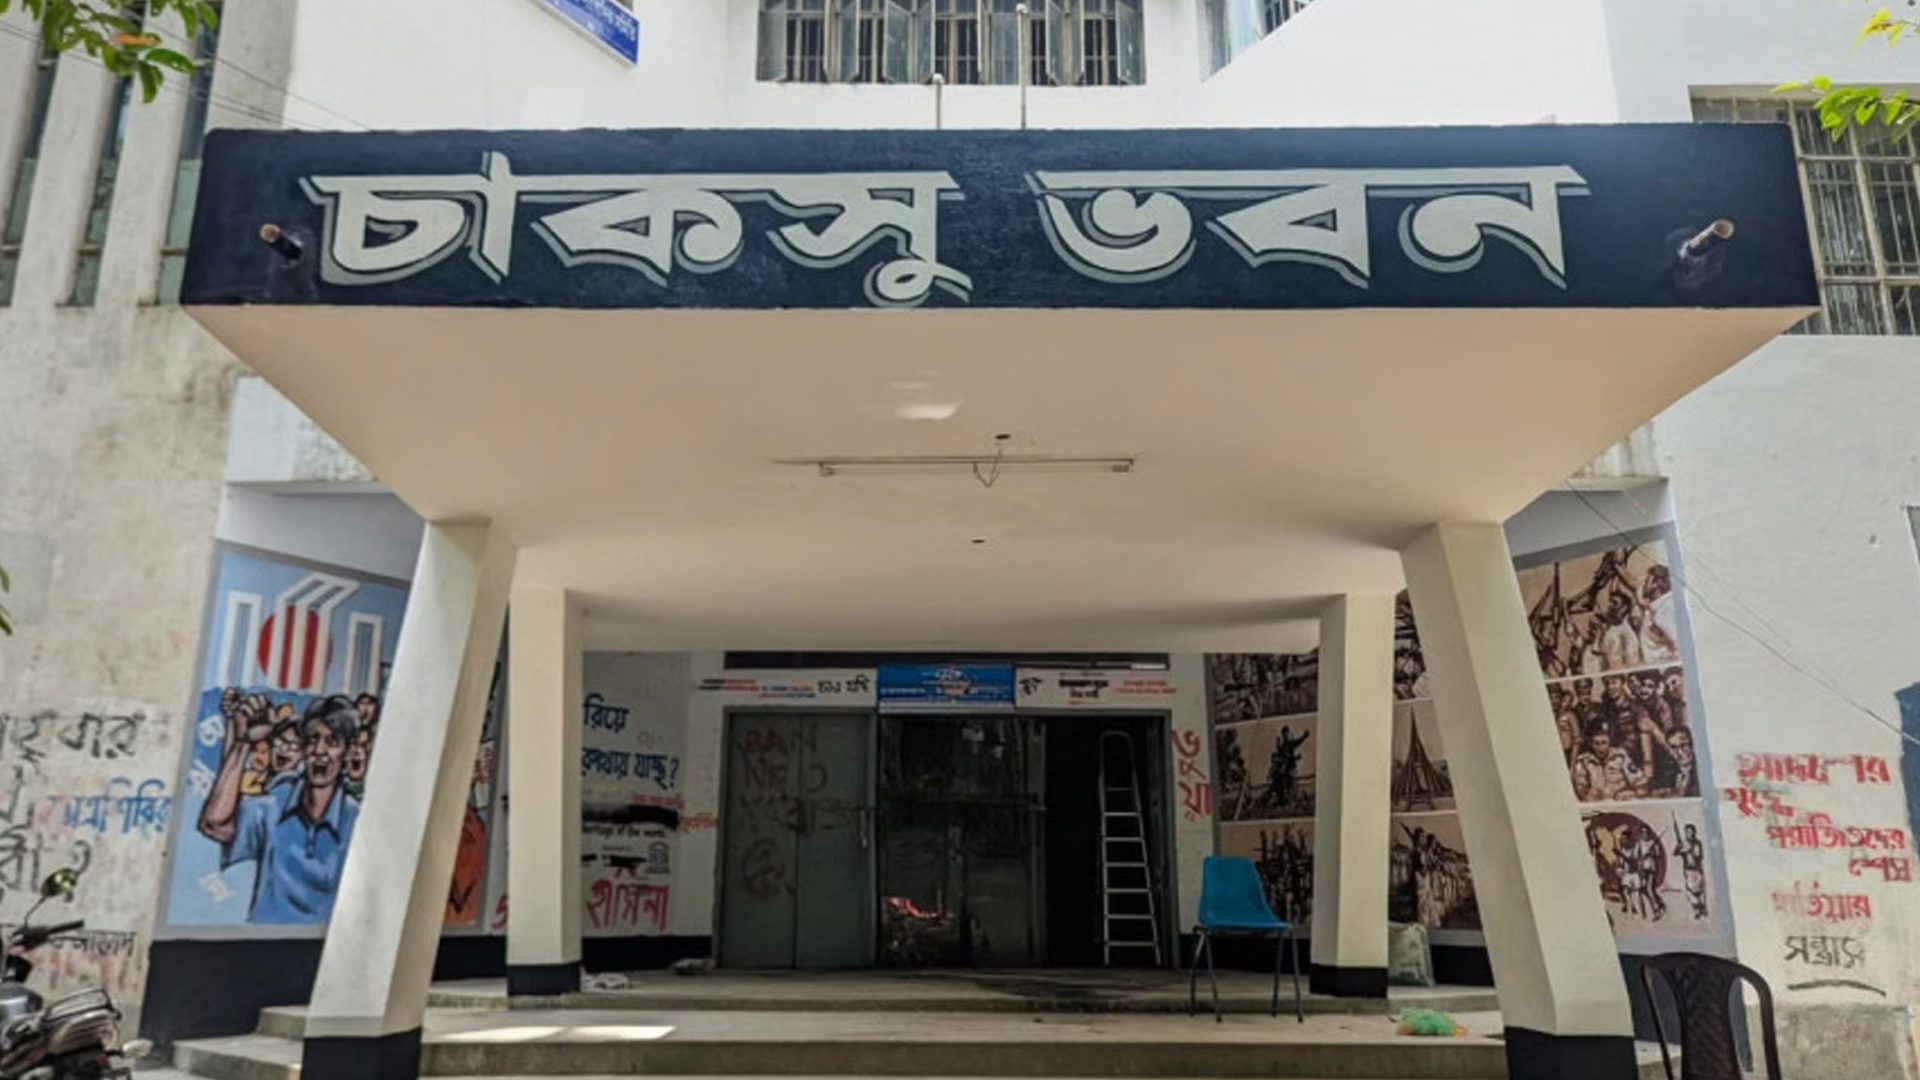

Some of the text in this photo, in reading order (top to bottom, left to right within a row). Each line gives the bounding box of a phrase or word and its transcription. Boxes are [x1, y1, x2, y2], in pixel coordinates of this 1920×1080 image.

[299, 151, 1591, 308] চাকসু ভবন
[582, 693, 629, 731] রিয়ে
